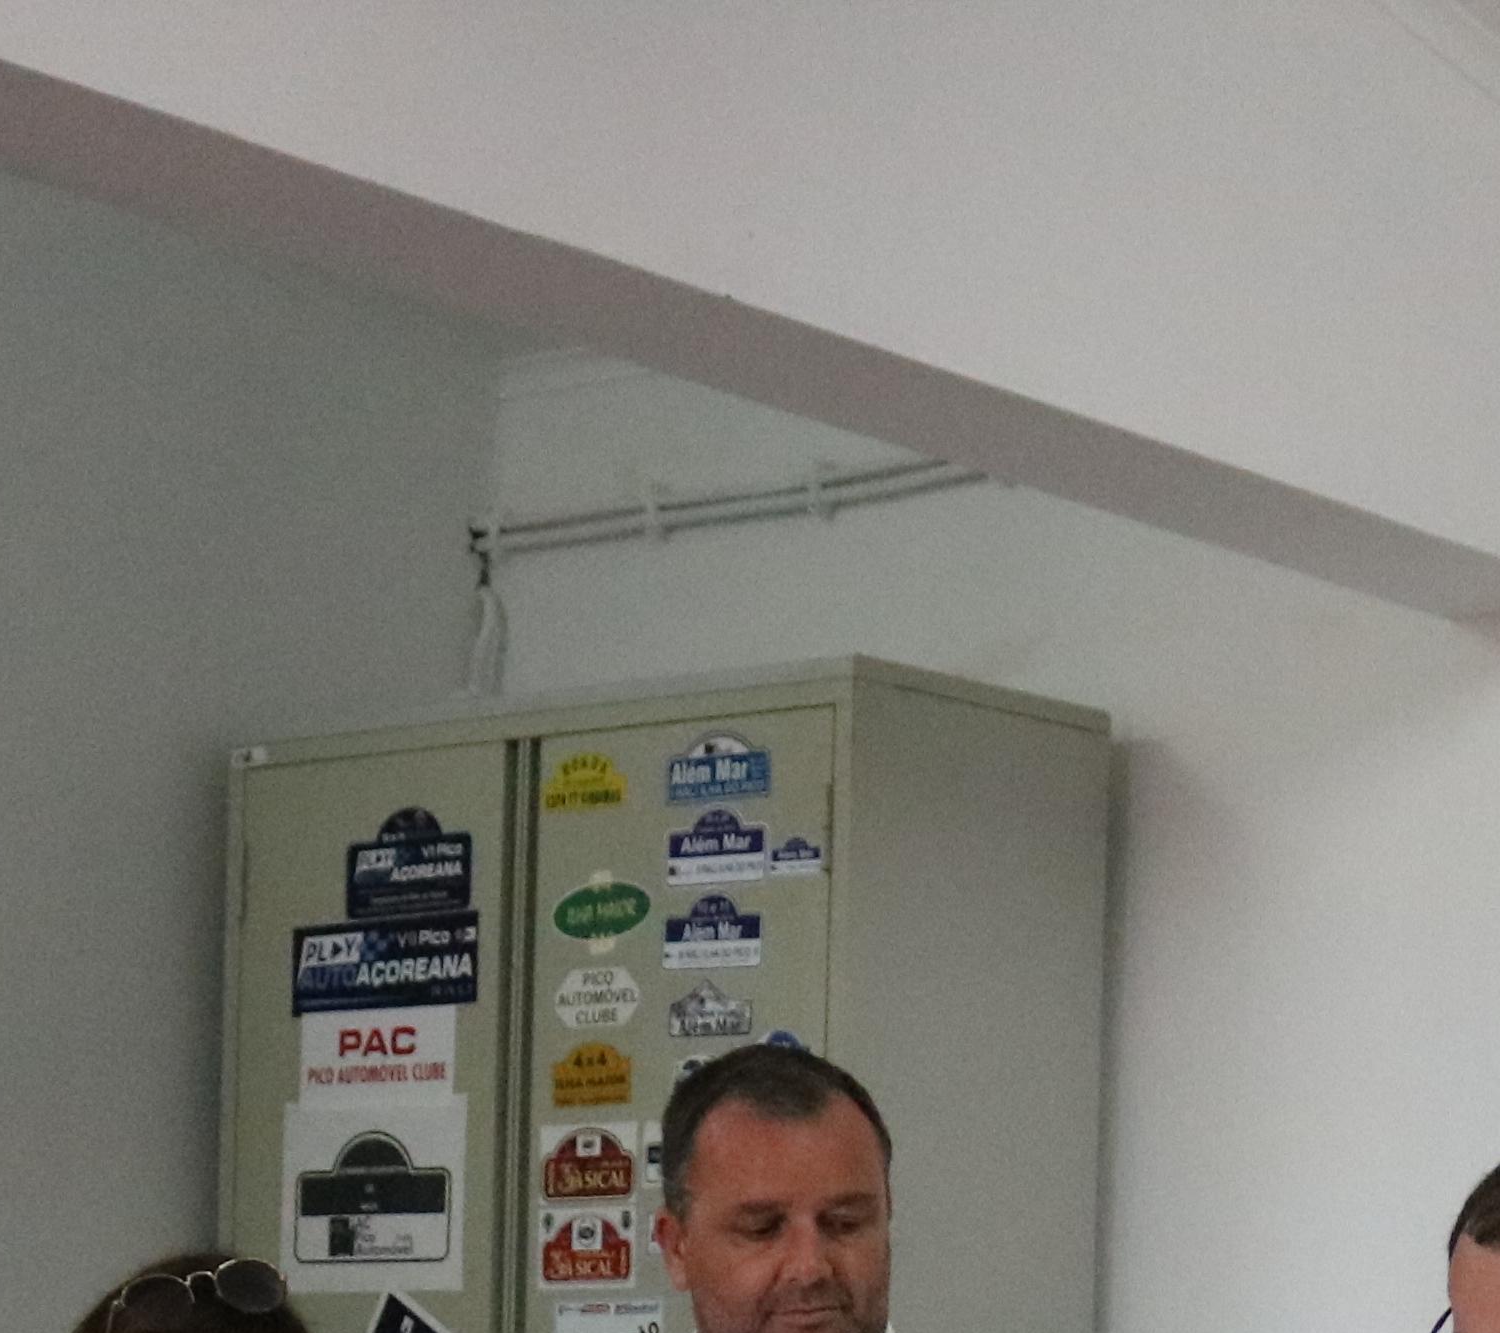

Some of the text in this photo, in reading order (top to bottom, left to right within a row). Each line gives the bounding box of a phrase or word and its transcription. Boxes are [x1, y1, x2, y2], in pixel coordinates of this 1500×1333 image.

[715, 757, 748, 781] Mar
[722, 832, 751, 851] Mar
[717, 919, 743, 940] Mar
[582, 970, 614, 986] PICO
[575, 1007, 618, 1024] CLUBE
[338, 1025, 417, 1058] PAC
[307, 1065, 334, 1085] PICO
[412, 1060, 447, 1082] CLUBE
